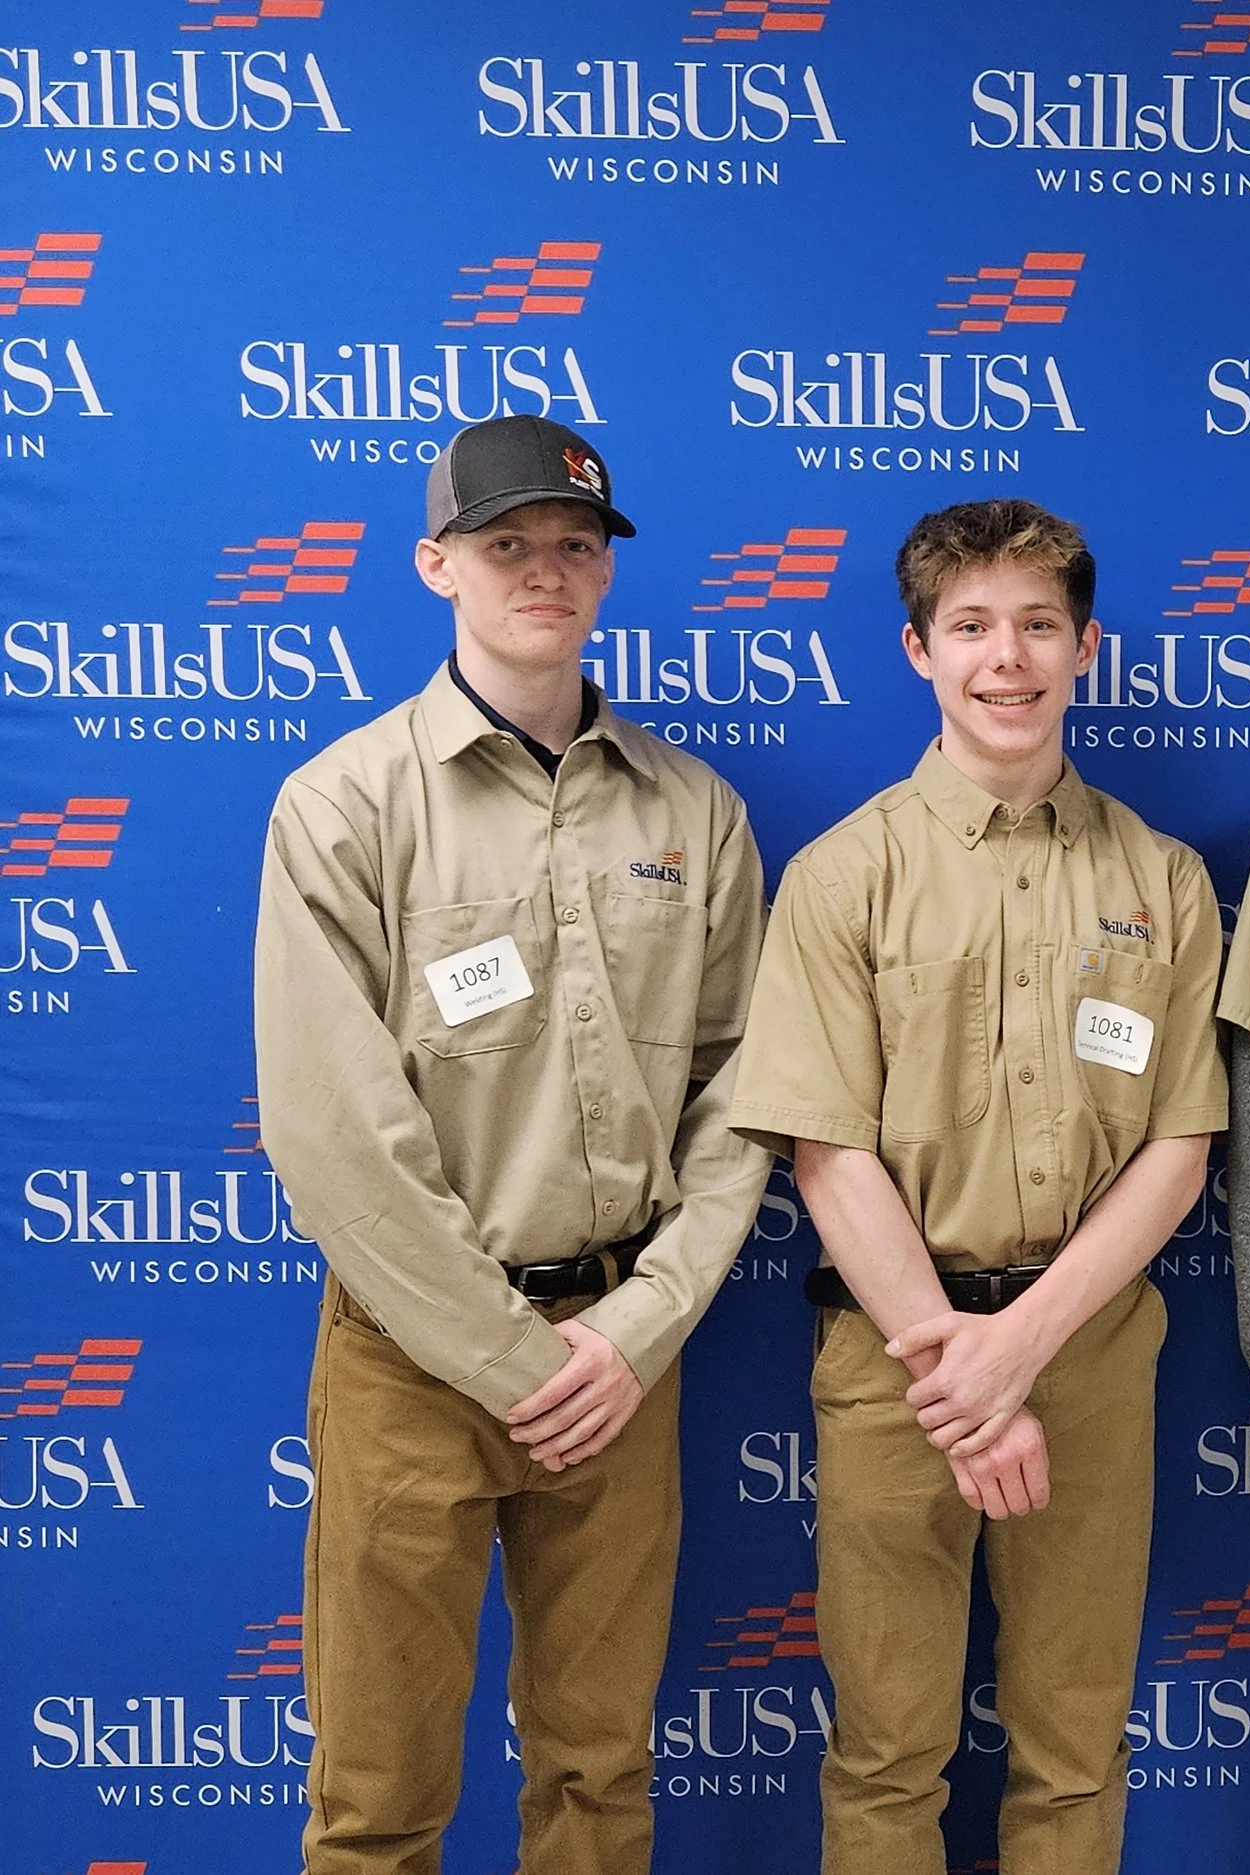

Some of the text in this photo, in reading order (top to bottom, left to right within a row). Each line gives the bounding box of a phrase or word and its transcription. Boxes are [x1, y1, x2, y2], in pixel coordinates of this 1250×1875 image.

[479, 57, 845, 143] SkillsUSA
[45, 148, 283, 174] WISCONSIN
[549, 157, 778, 185] WISCONSIN
[240, 341, 606, 423] SkillsUSA
[731, 350, 1085, 432] SkillsUSA
[311, 439, 441, 463] WISCO
[797, 446, 1019, 472] WISCONSIN
[5, 621, 372, 700] SkillsUSA
[580, 629, 850, 705] illsUSA
[75, 716, 306, 741] WISCONSIN
[1071, 725, 1249, 749] ISCONSIN
[630, 862, 681, 885] SkillsUSA
[449, 957, 500, 993] 1087
[1088, 1015, 1134, 1044] 1081
[24, 1168, 317, 1245] SkillsU
[91, 1260, 317, 1283] WISCONSIN
[32, 1695, 315, 1769] SkillsUS
[1127, 1765, 1240, 1789] ONSIN
